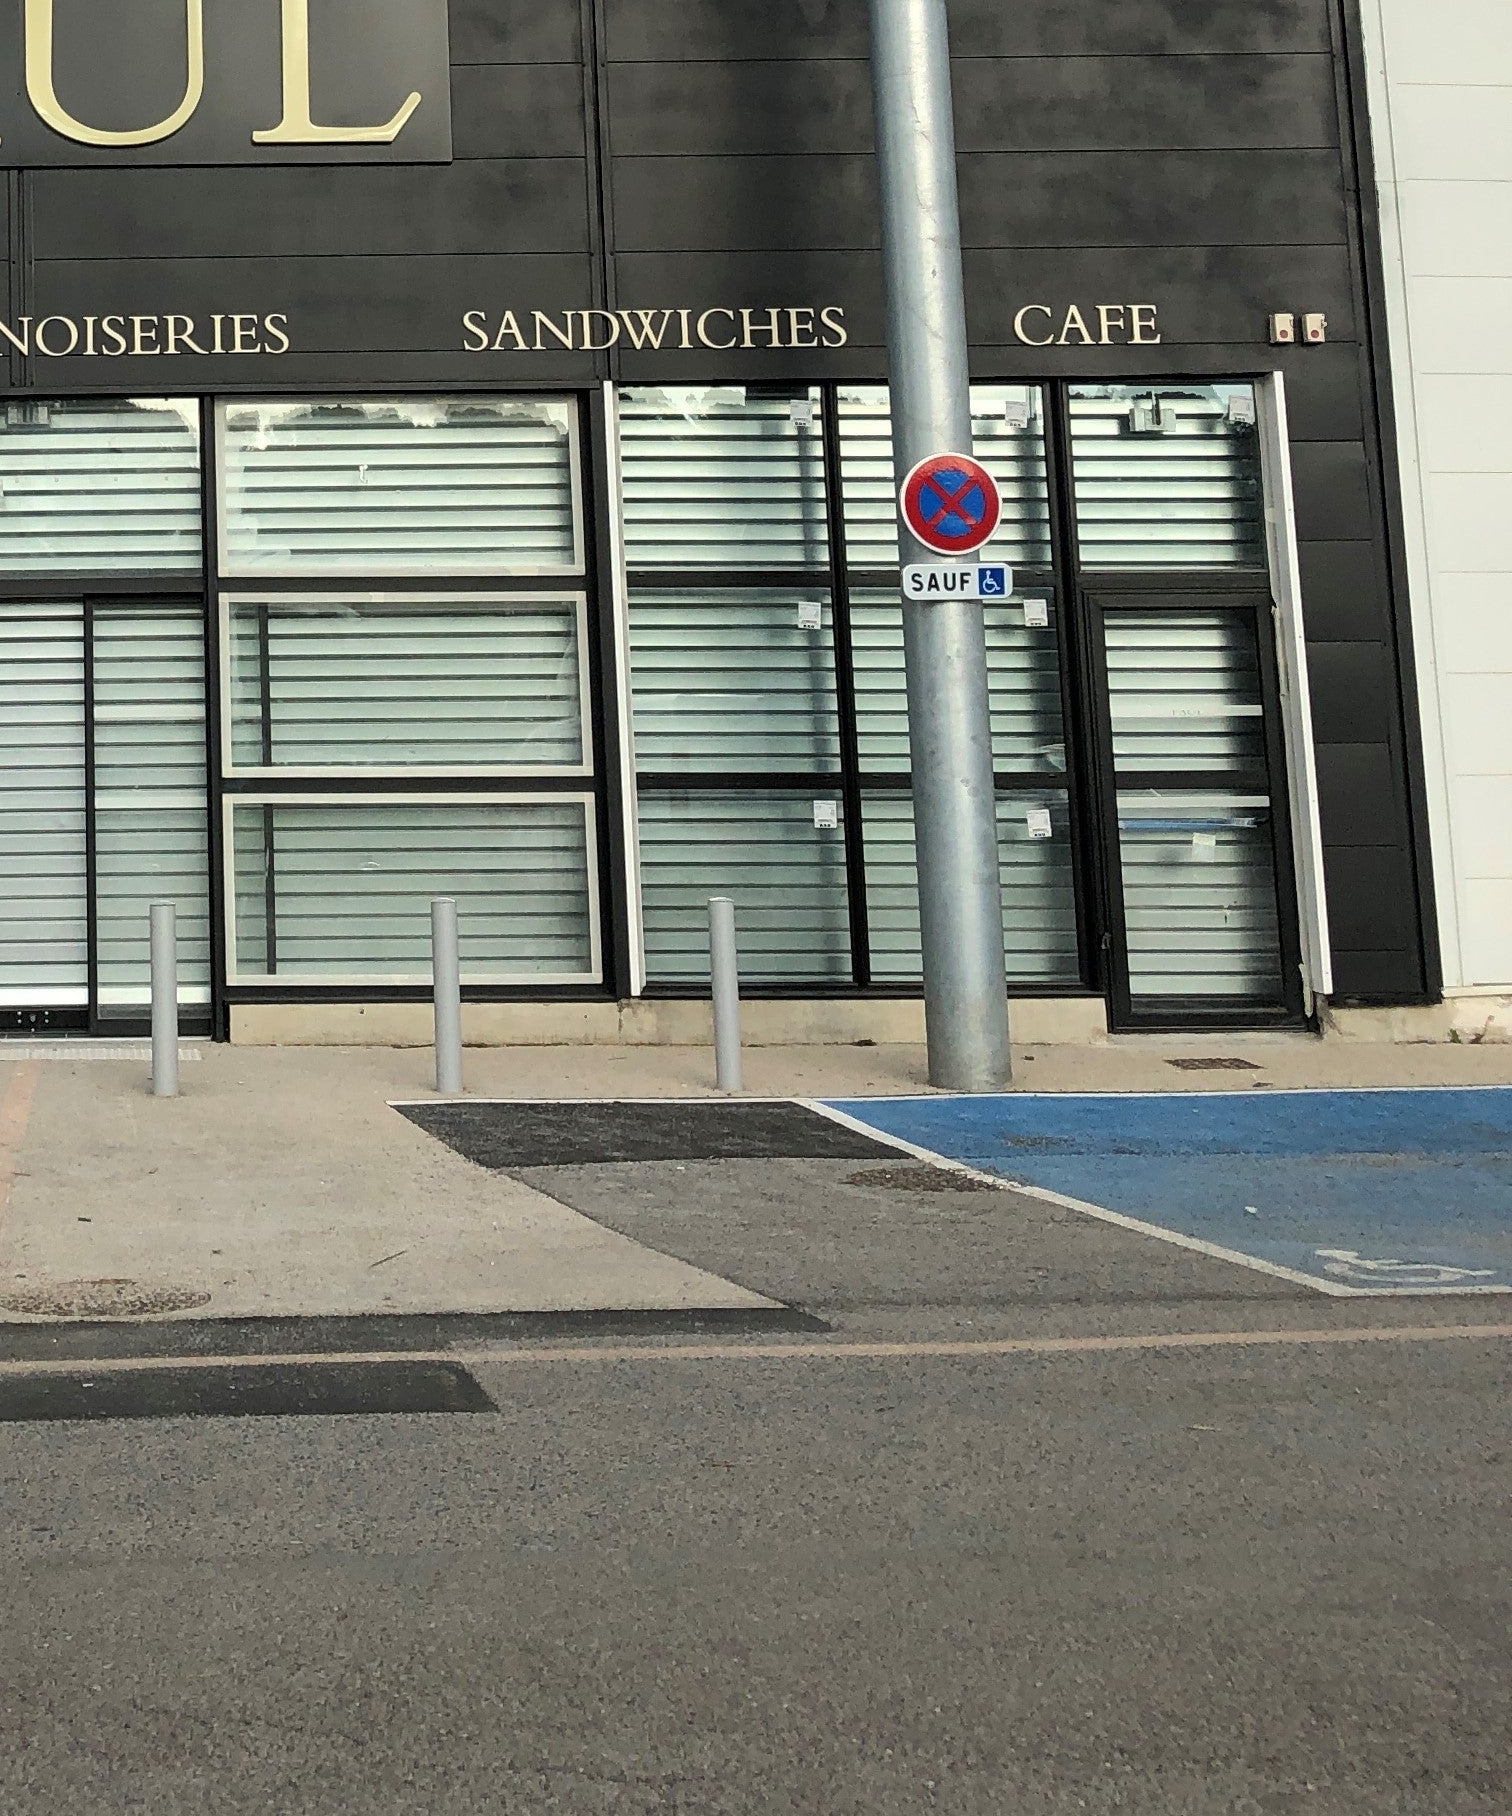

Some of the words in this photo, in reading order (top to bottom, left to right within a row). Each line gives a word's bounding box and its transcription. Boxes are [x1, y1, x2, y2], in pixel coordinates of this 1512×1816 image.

[462, 306, 848, 352] SANDWICHES
[1014, 304, 1161, 346] CAFE
[910, 572, 972, 592] SAUF
